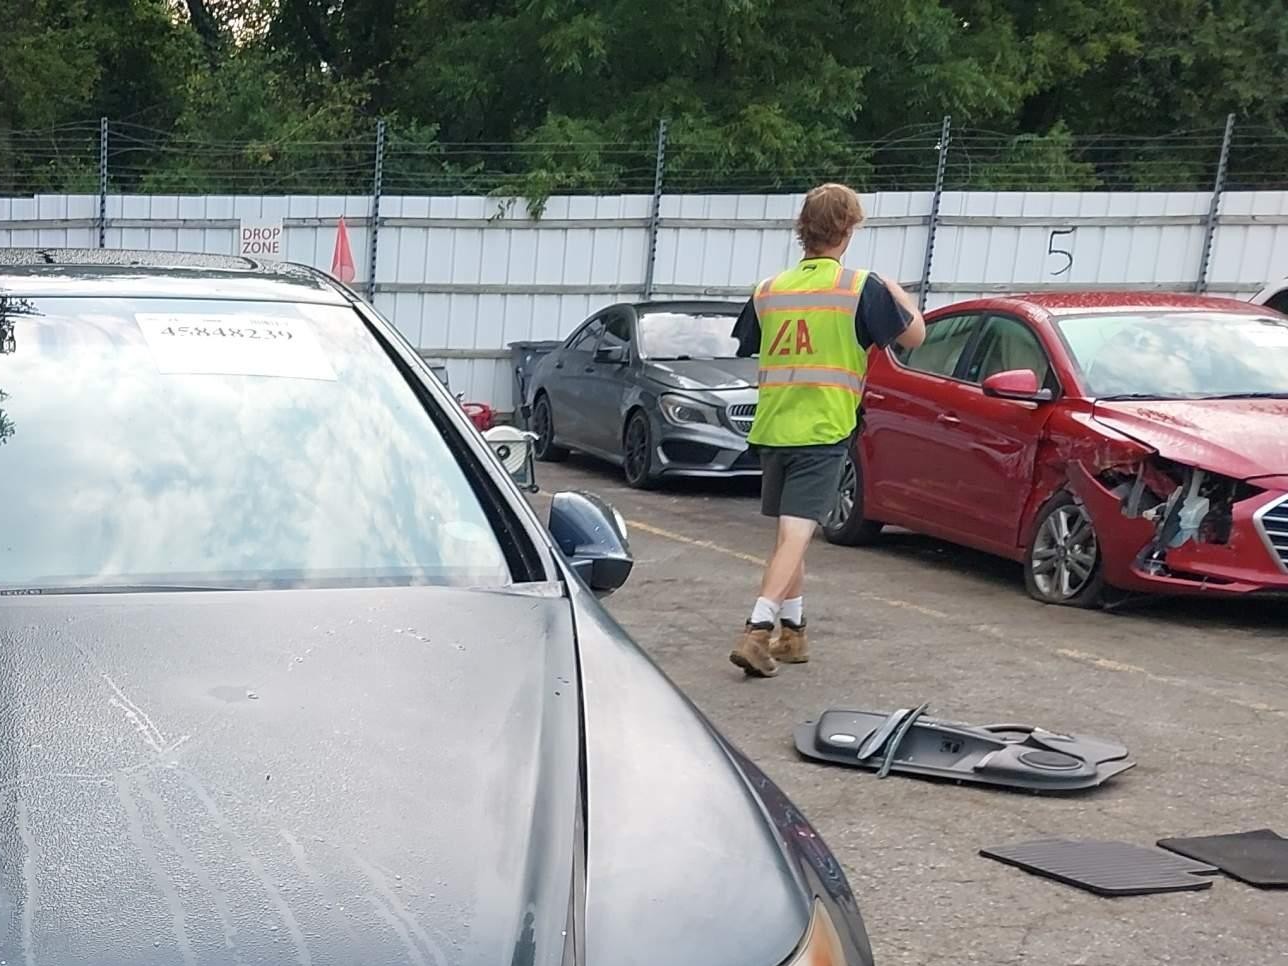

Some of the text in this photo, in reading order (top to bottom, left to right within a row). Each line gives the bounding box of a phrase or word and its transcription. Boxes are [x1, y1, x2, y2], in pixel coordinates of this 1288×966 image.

[242, 228, 281, 241] DROP
[242, 242, 280, 254] ZONE
[1047, 226, 1077, 277] 5
